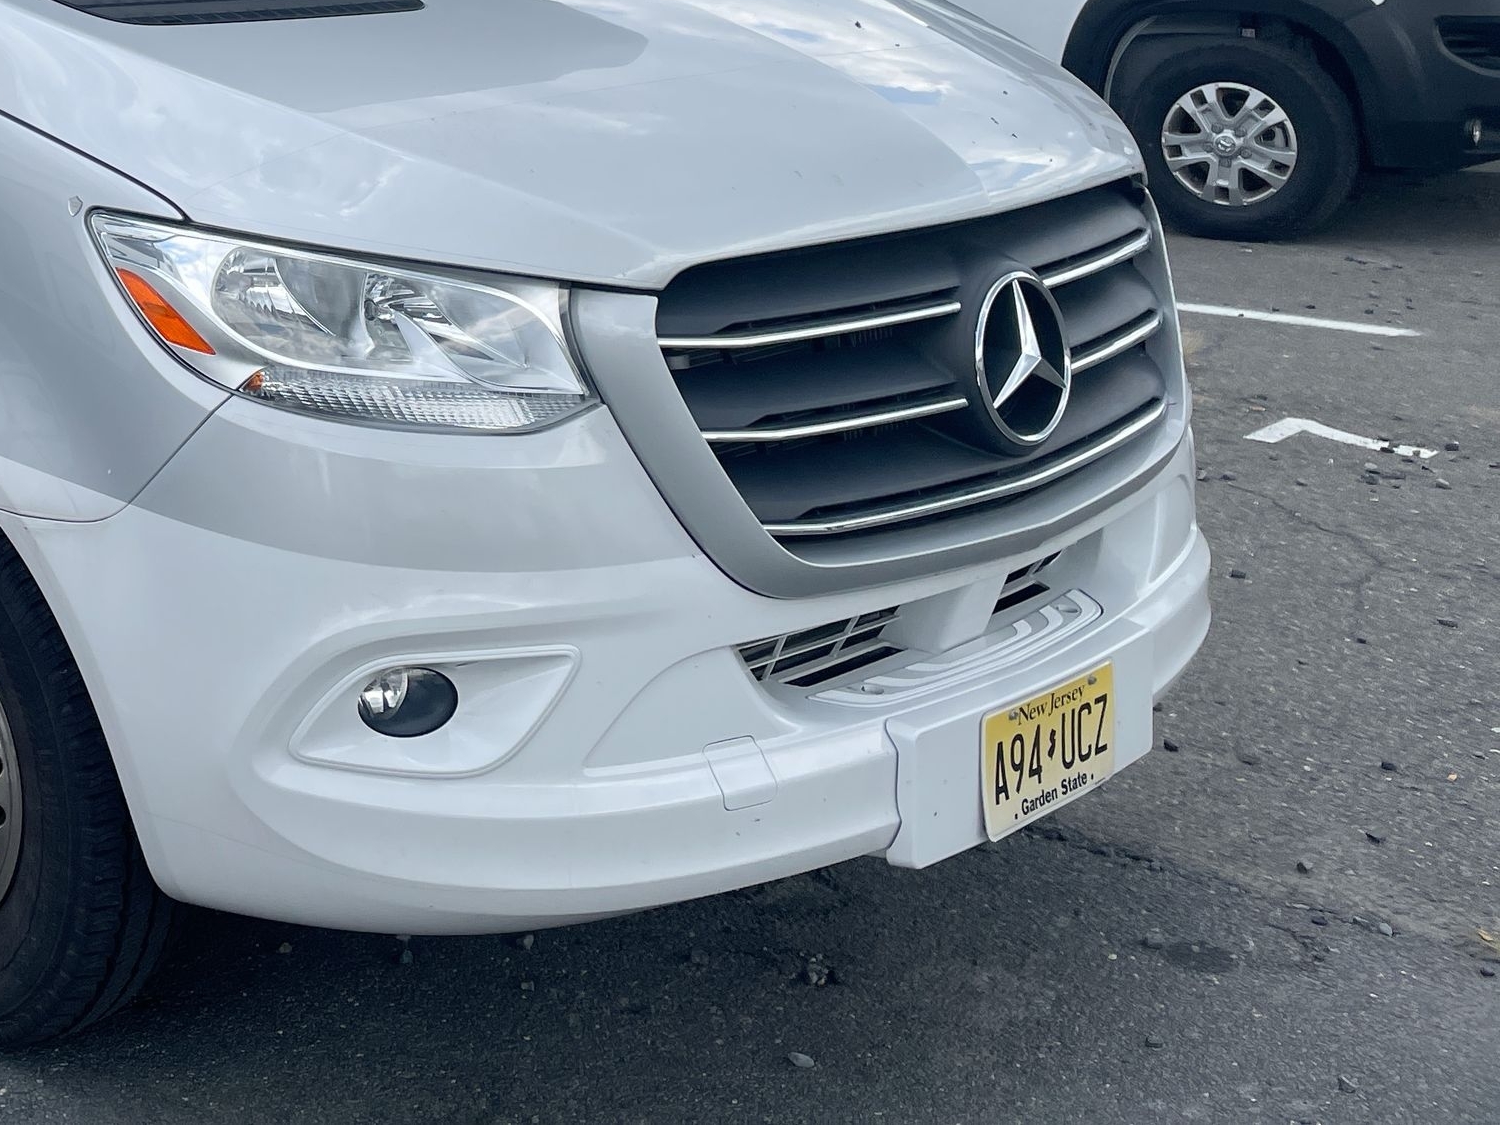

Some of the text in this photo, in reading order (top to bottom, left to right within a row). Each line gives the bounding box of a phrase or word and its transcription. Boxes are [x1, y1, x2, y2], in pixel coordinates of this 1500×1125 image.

[1018, 685, 1086, 726] New Jersey
[1021, 771, 1088, 816] Garden State
